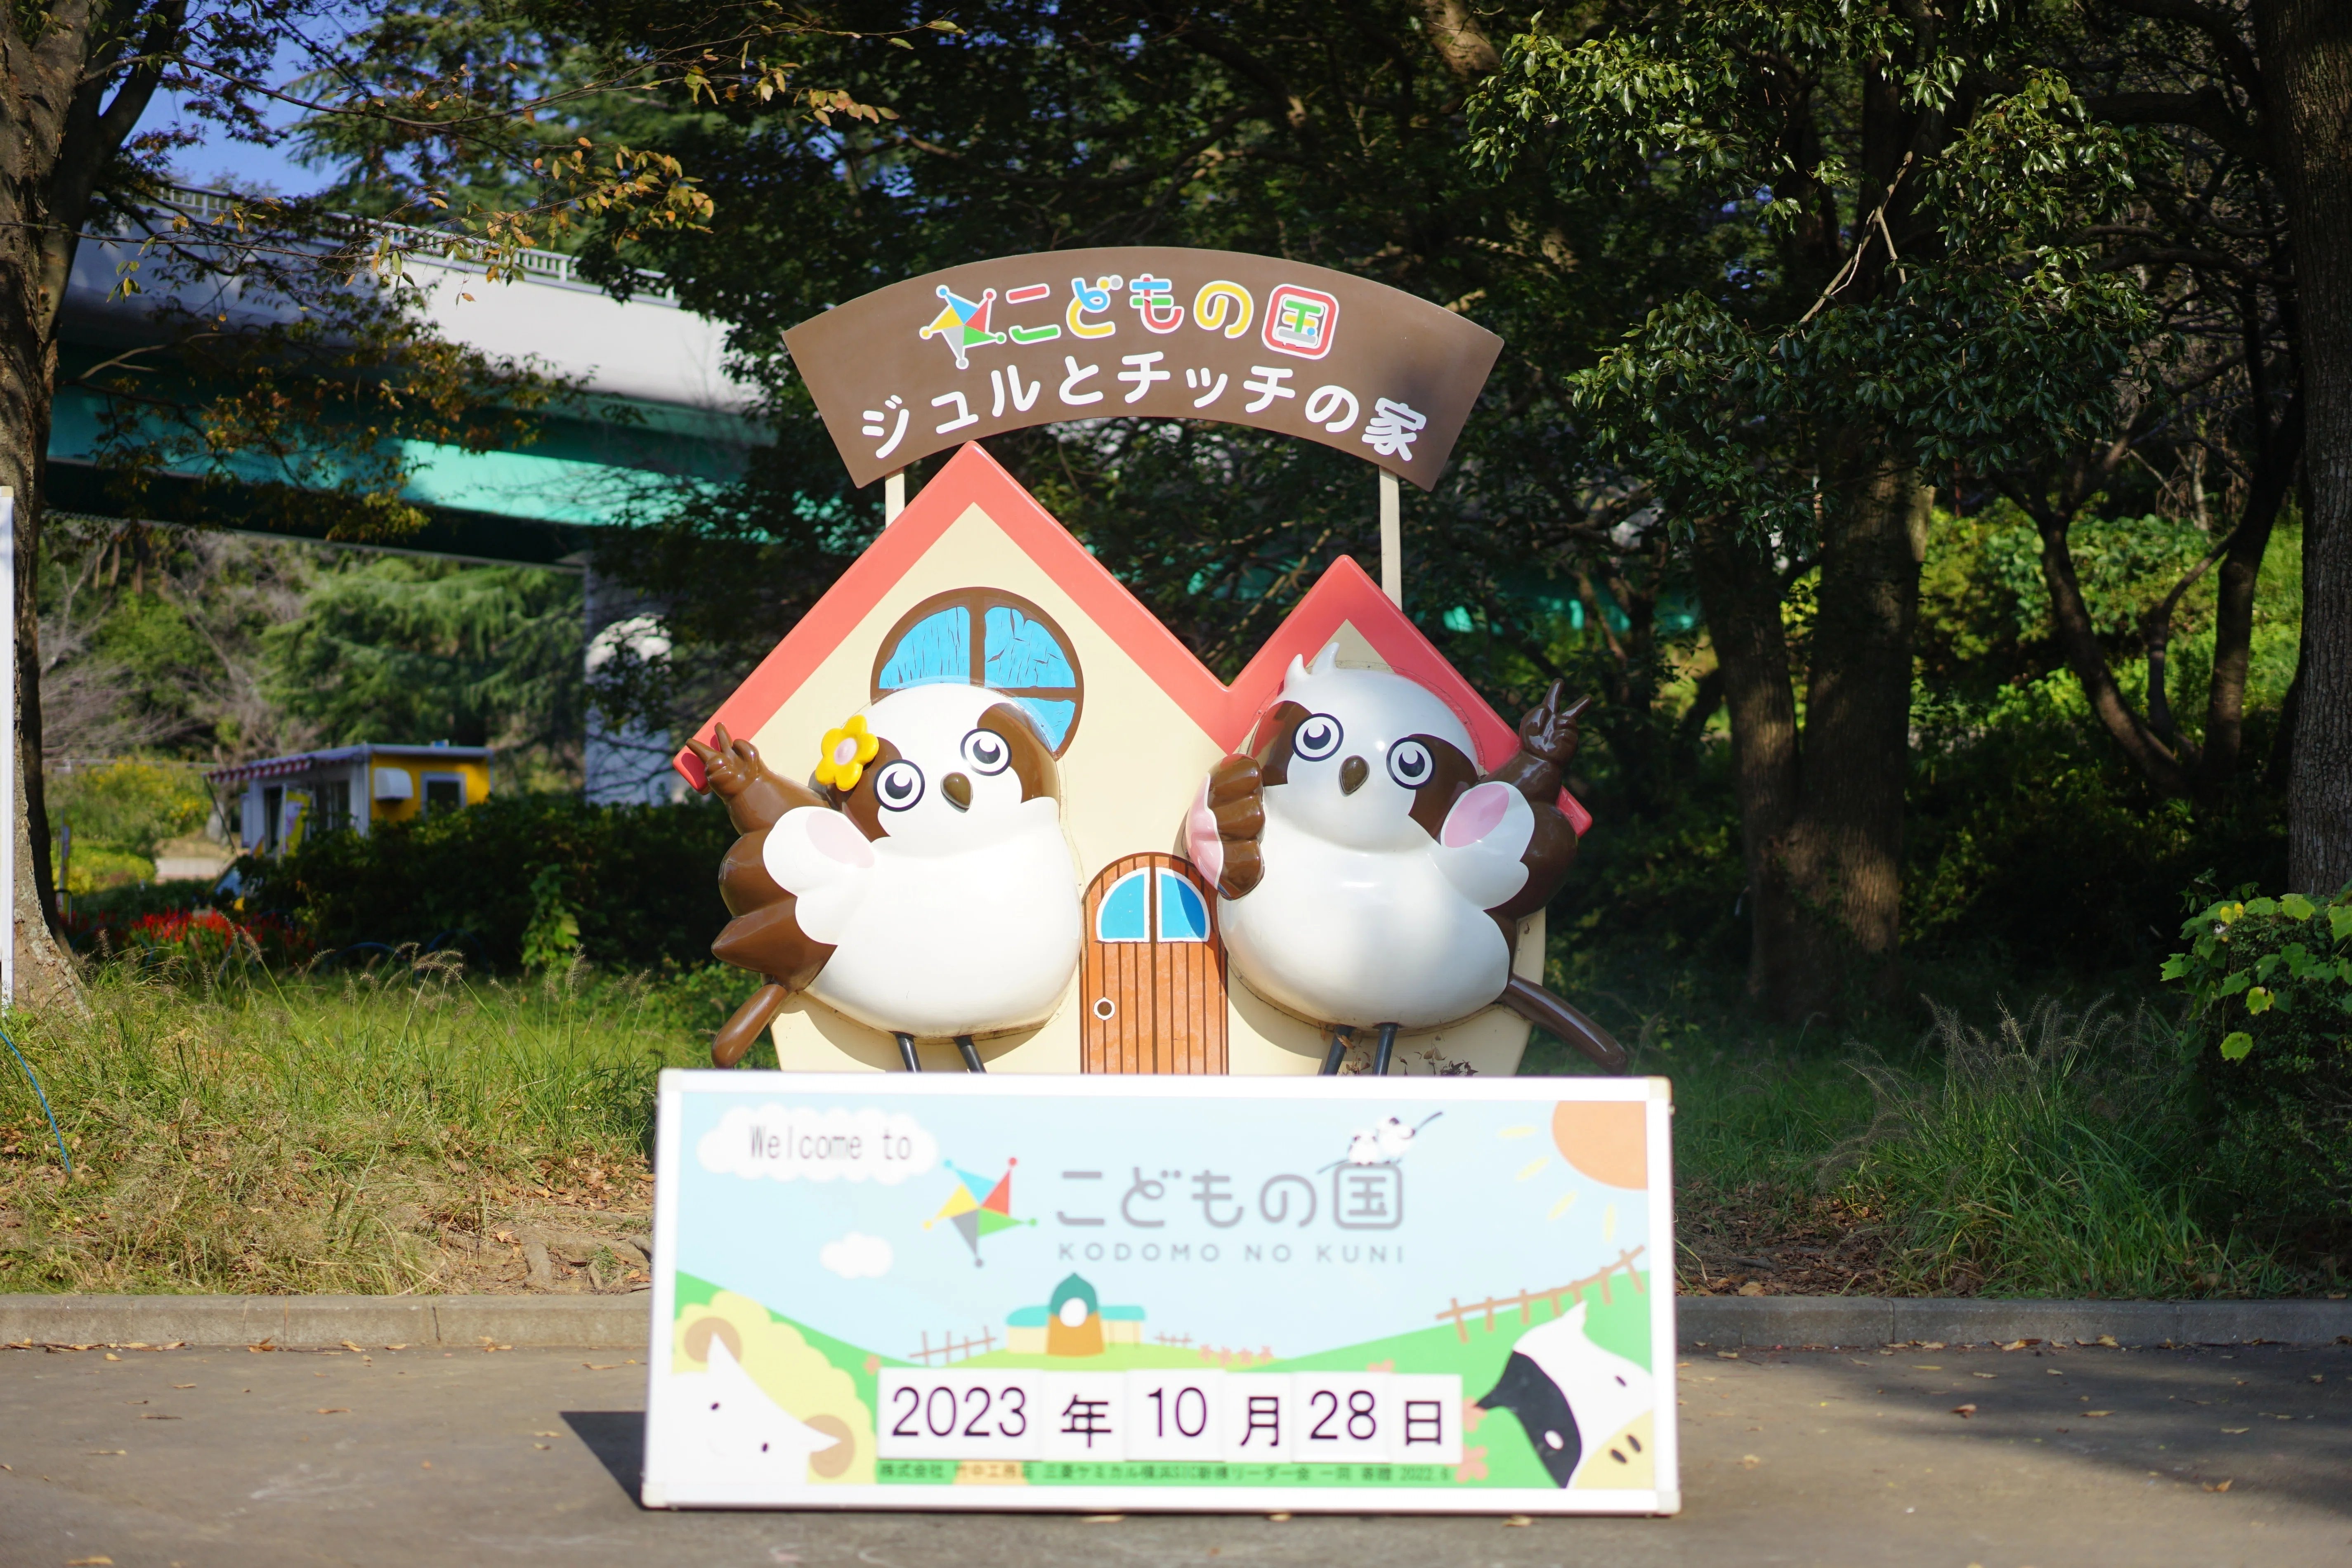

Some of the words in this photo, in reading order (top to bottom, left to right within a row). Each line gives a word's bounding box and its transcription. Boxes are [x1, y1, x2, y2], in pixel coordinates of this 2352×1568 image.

[1006, 274, 1339, 360] こどもの国
[862, 352, 1426, 461] ジュルとチッチの家
[750, 1126, 862, 1161] Welcome
[883, 1129, 912, 1161] to
[1057, 1162, 1403, 1231] こどもの国
[1059, 1242, 1220, 1263] KODOMO
[1245, 1243, 1292, 1263] NO
[1317, 1244, 1403, 1264] KUNI
[892, 1386, 1026, 1438] 2023
[1061, 1394, 1112, 1449] 年
[1148, 1387, 1207, 1438] 10
[1240, 1396, 1279, 1448] 月
[1310, 1390, 1376, 1440] 28
[1405, 1400, 1442, 1447] 日
